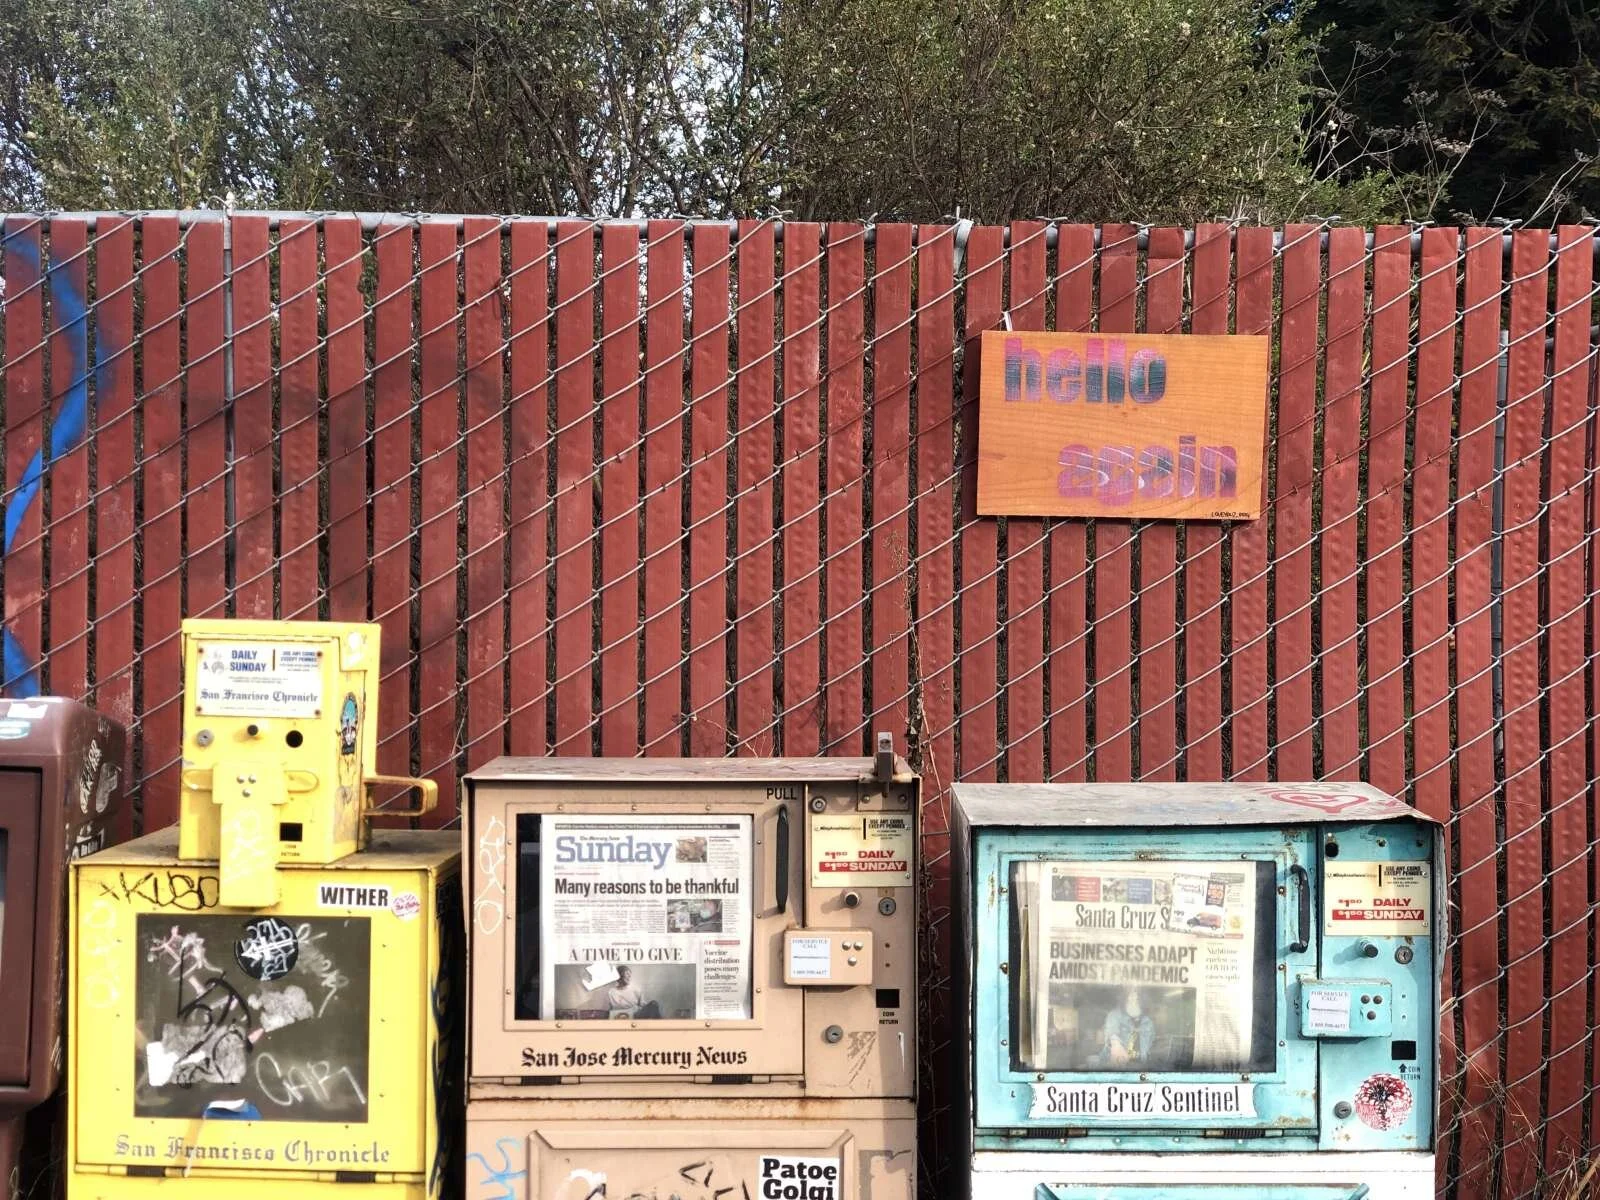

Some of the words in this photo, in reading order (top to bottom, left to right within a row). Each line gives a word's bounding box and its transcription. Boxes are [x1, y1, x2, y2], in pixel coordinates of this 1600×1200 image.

[1005, 337, 1167, 403] hello
[1058, 435, 1237, 507] again
[231, 650, 258, 660] DAILY
[230, 661, 267, 672] SUNDAY
[200, 688, 220, 700] San
[222, 688, 269, 701] Francisco
[272, 691, 318, 704] Chronicle
[766, 787, 797, 800] PULL
[556, 835, 673, 870] Sunday
[858, 850, 895, 859] DAILY
[849, 862, 904, 871] SUNDAY
[321, 886, 389, 907] WITHER
[555, 878, 591, 898] Many
[593, 883, 647, 894] reasons
[649, 879, 663, 894] to
[666, 878, 682, 894] be
[684, 878, 739, 894] thankful
[1373, 898, 1412, 907] DAILY
[1075, 903, 1116, 928] Santa
[1120, 905, 1156, 930] Cruz
[1363, 910, 1421, 920] SUNDAY
[569, 948, 578, 961] A
[582, 948, 620, 961] TIME
[621, 948, 644, 962] TO
[648, 947, 683, 962] GIVE
[1050, 941, 1146, 963] BUSINESSES
[1147, 944, 1198, 964] ADAPT
[1049, 962, 1108, 981] AMIDST
[1110, 962, 1189, 984] PANDEMIC
[522, 1047, 559, 1067] San
[563, 1047, 607, 1067] Jose
[612, 1046, 691, 1069] Mercury
[695, 1046, 748, 1066] News
[1047, 1086, 1098, 1113] Santa
[1107, 1086, 1153, 1113] Cruz
[1161, 1085, 1240, 1113] Sentinel
[114, 1134, 156, 1157] San
[164, 1136, 275, 1161] Francisco
[285, 1140, 390, 1165] Chronicle
[762, 1158, 837, 1180] Patoe
